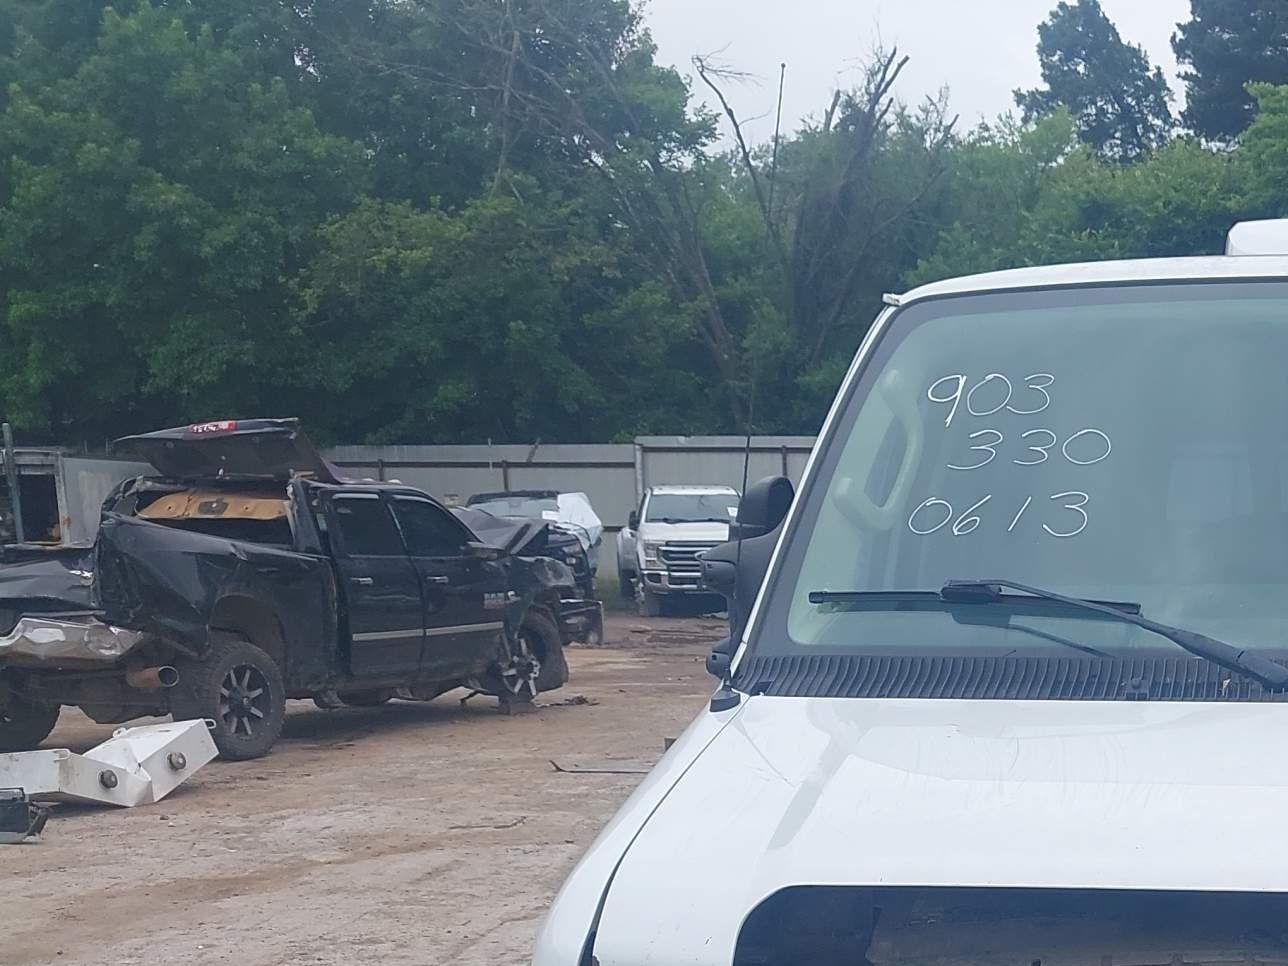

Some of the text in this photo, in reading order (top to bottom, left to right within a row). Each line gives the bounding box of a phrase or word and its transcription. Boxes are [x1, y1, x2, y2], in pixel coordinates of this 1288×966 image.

[927, 373, 1055, 427] 903
[947, 429, 1112, 470] 330
[908, 491, 1090, 537] 0613
